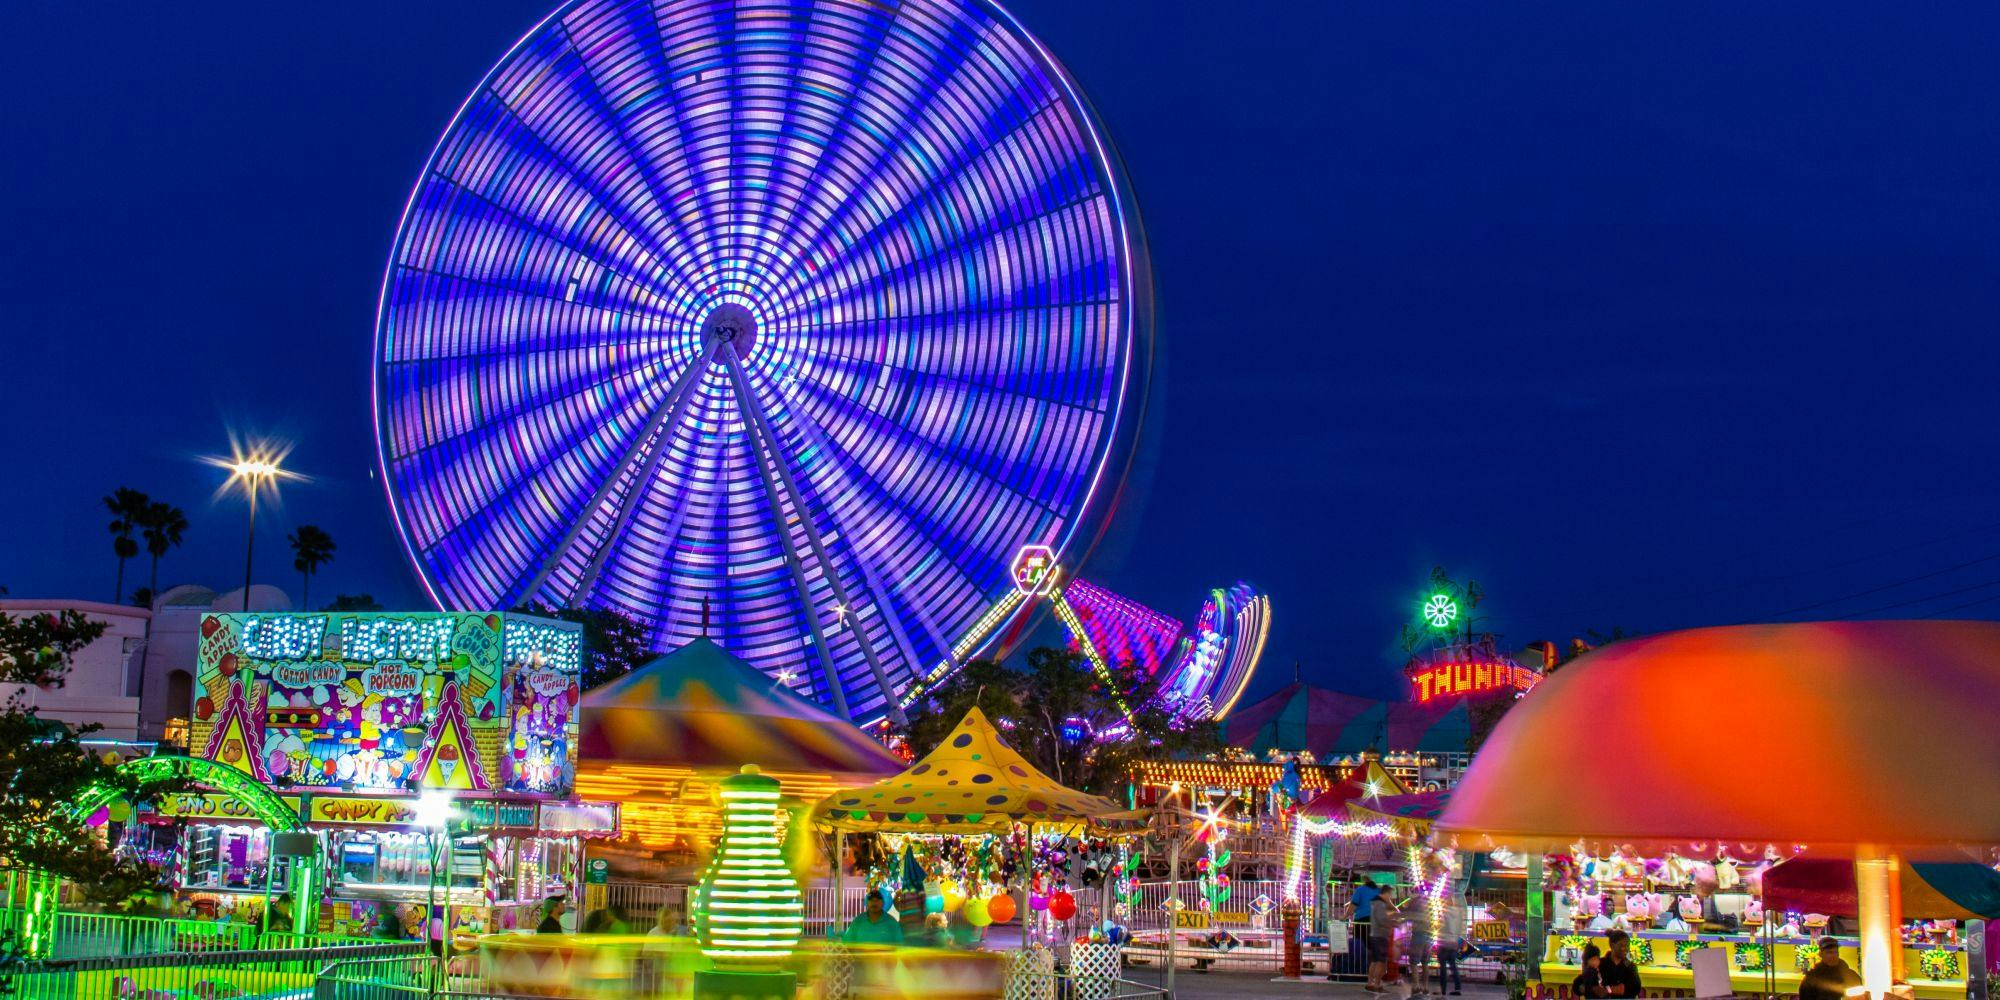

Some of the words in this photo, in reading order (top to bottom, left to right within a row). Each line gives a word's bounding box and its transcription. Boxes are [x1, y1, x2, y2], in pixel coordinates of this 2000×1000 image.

[202, 623, 231, 656] CANDY
[242, 614, 328, 660] CANDY
[341, 616, 458, 662] FACTORY
[469, 625, 492, 650] SNO
[207, 634, 240, 668] APPLES
[456, 635, 489, 668] CONES
[279, 666, 310, 683] COTTON
[312, 665, 341, 682] CANDY
[381, 664, 401, 673] HOT
[532, 673, 554, 683] CANDY
[370, 674, 416, 690] POPCORN
[542, 678, 566, 691] APPLES
[176, 795, 216, 815] SNO
[320, 798, 382, 821] CANDY
[1176, 912, 1204, 928] EXIT
[1475, 922, 1507, 938] ENTER
